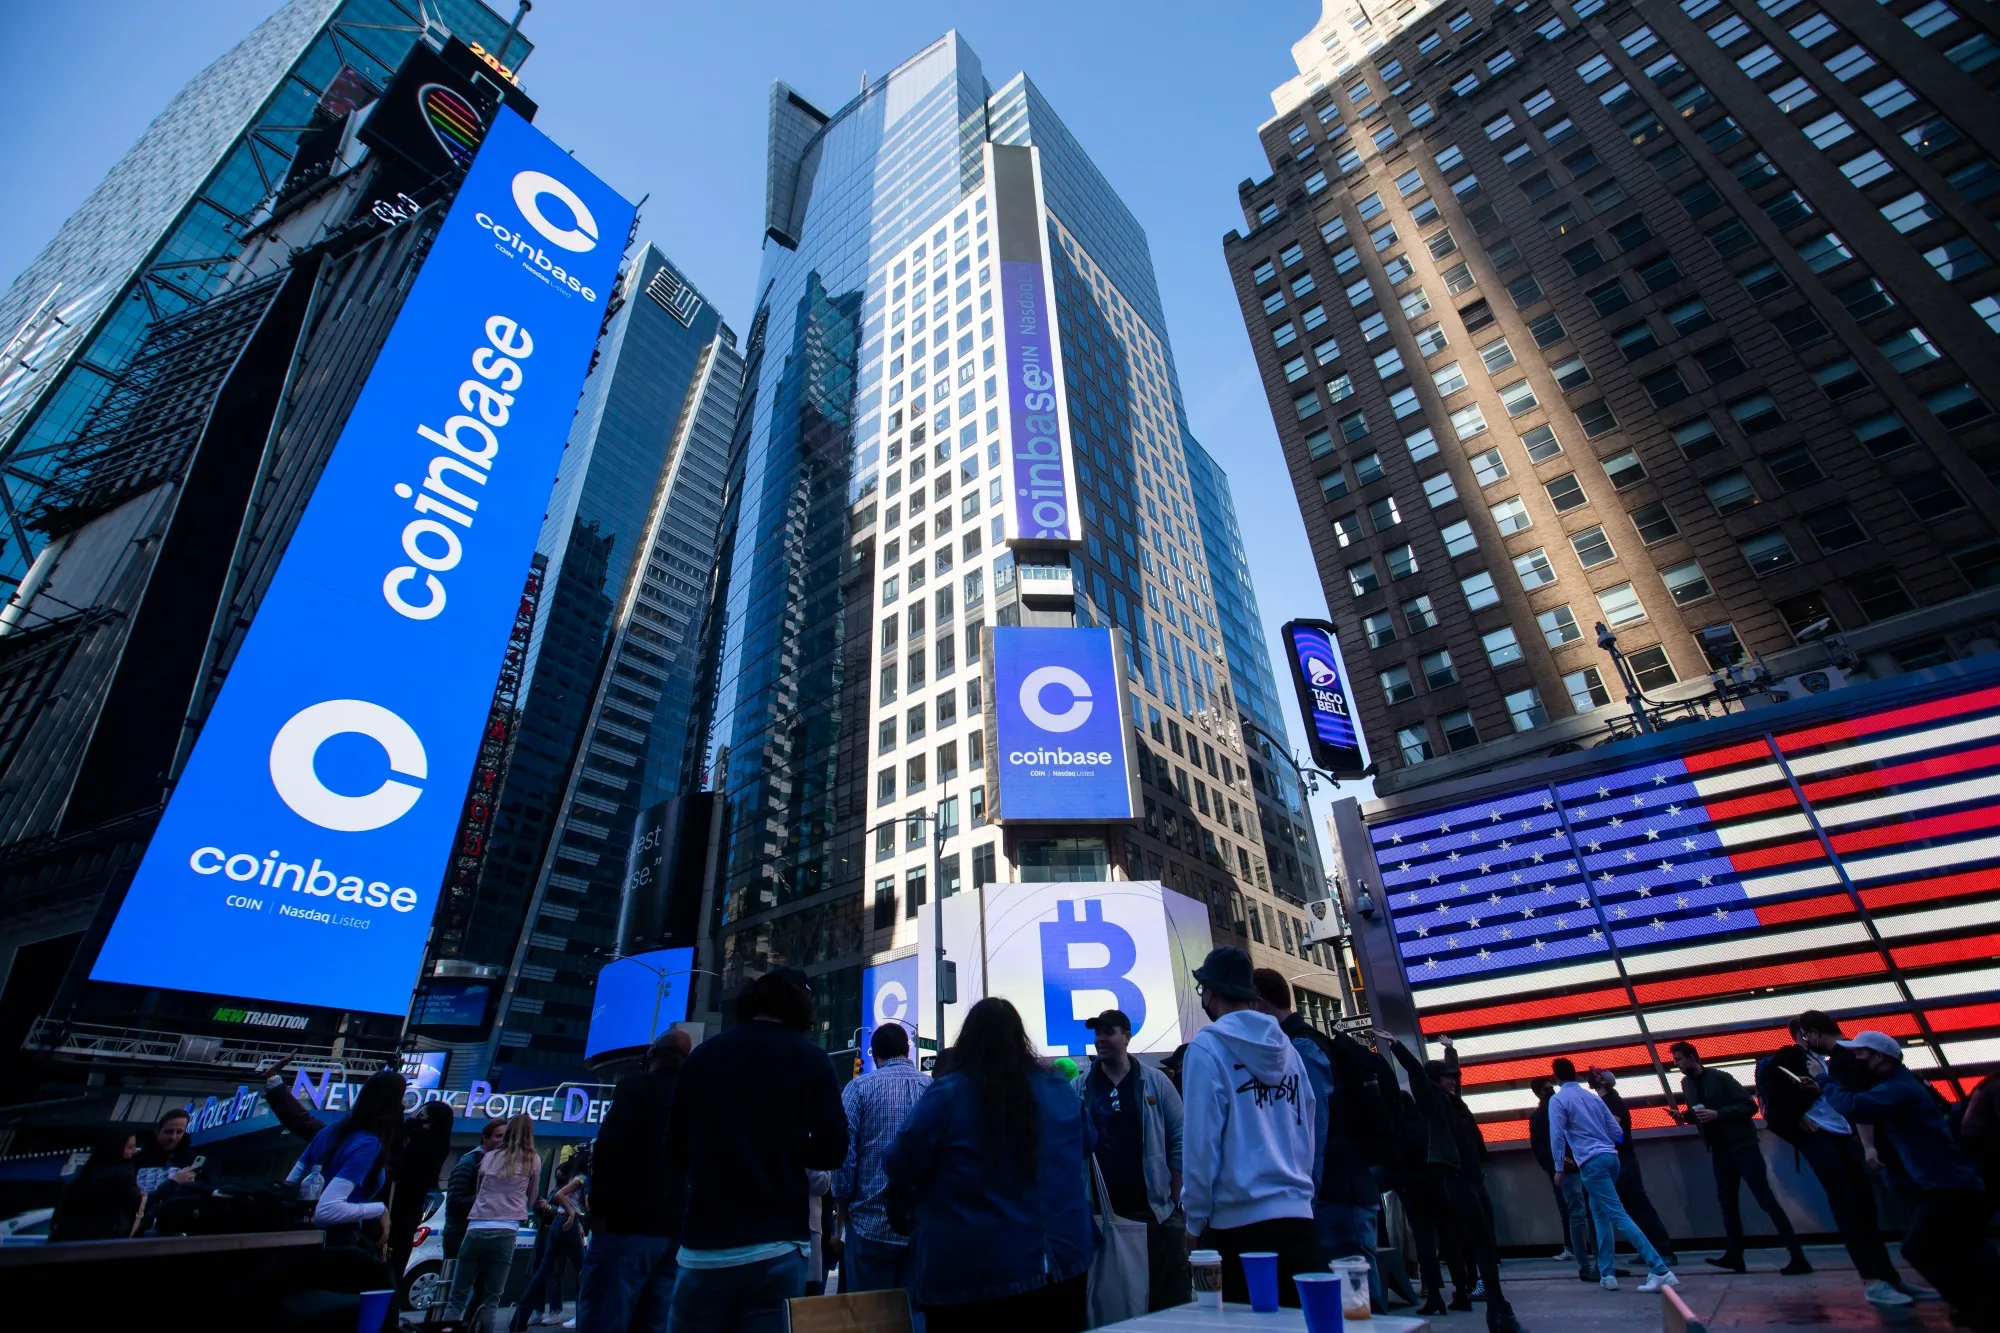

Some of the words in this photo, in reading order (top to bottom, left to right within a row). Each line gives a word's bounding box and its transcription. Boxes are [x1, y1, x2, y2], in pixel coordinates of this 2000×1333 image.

[475, 212, 597, 303] coinbase
[494, 242, 515, 260] COIN
[522, 260, 551, 285] Nasdaq
[382, 314, 535, 621] coinbase
[1311, 688, 1343, 704] TACO
[1316, 701, 1347, 716] BELL
[1009, 746, 1113, 766] coinbase
[1052, 770, 1076, 778] Nasdaq
[189, 846, 419, 913] coinbase
[226, 894, 264, 912] COIN
[279, 903, 331, 925] Nasdaq
[331, 913, 371, 930] Listed
[1336, 1021, 1350, 1031] ONE
[1354, 1018, 1369, 1027] WAY
[464, 1079, 554, 1121] POLICE
